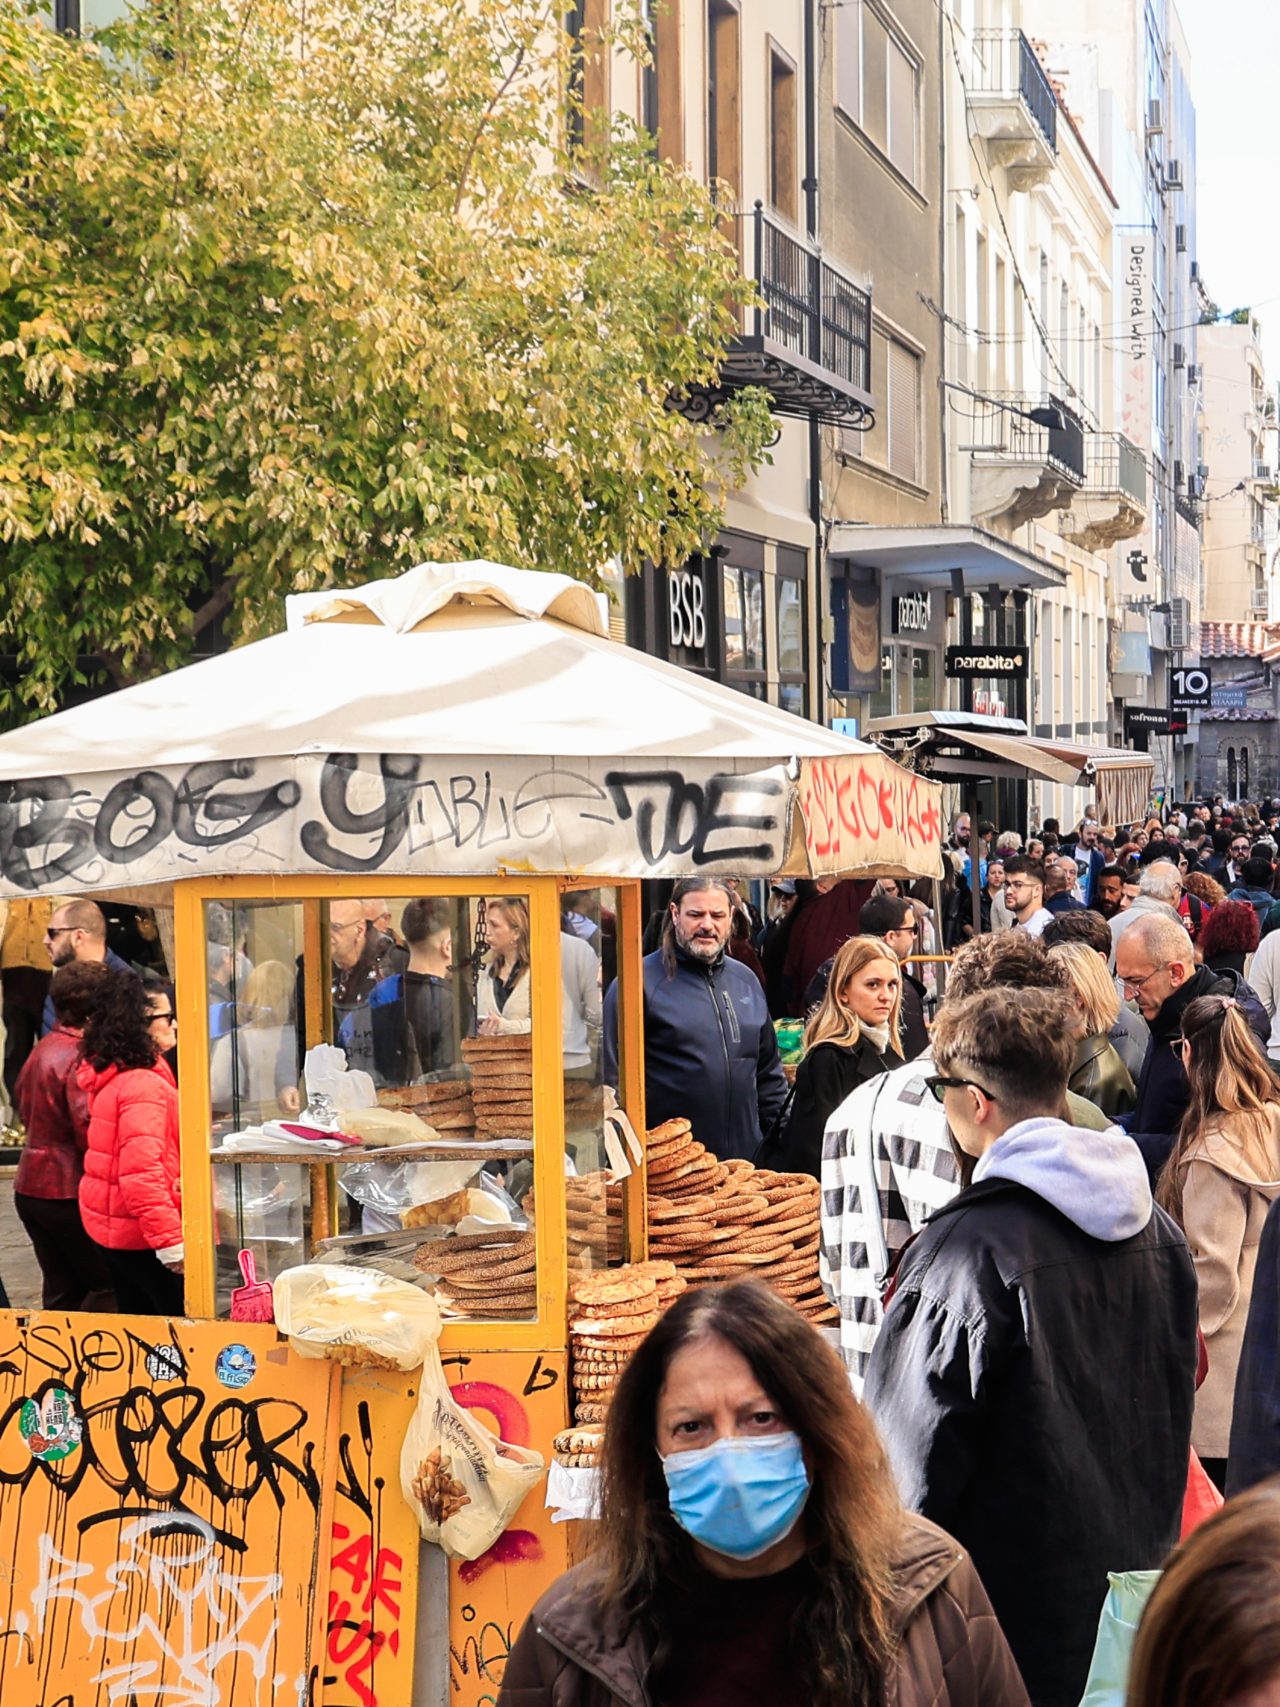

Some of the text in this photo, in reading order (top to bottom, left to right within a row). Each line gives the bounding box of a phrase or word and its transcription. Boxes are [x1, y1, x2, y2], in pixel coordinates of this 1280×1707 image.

[1126, 246, 1146, 361] Designed with
[669, 573, 706, 648] BSB
[898, 591, 927, 634] parabita
[954, 654, 1014, 670] parabita
[1173, 671, 1209, 694] 10
